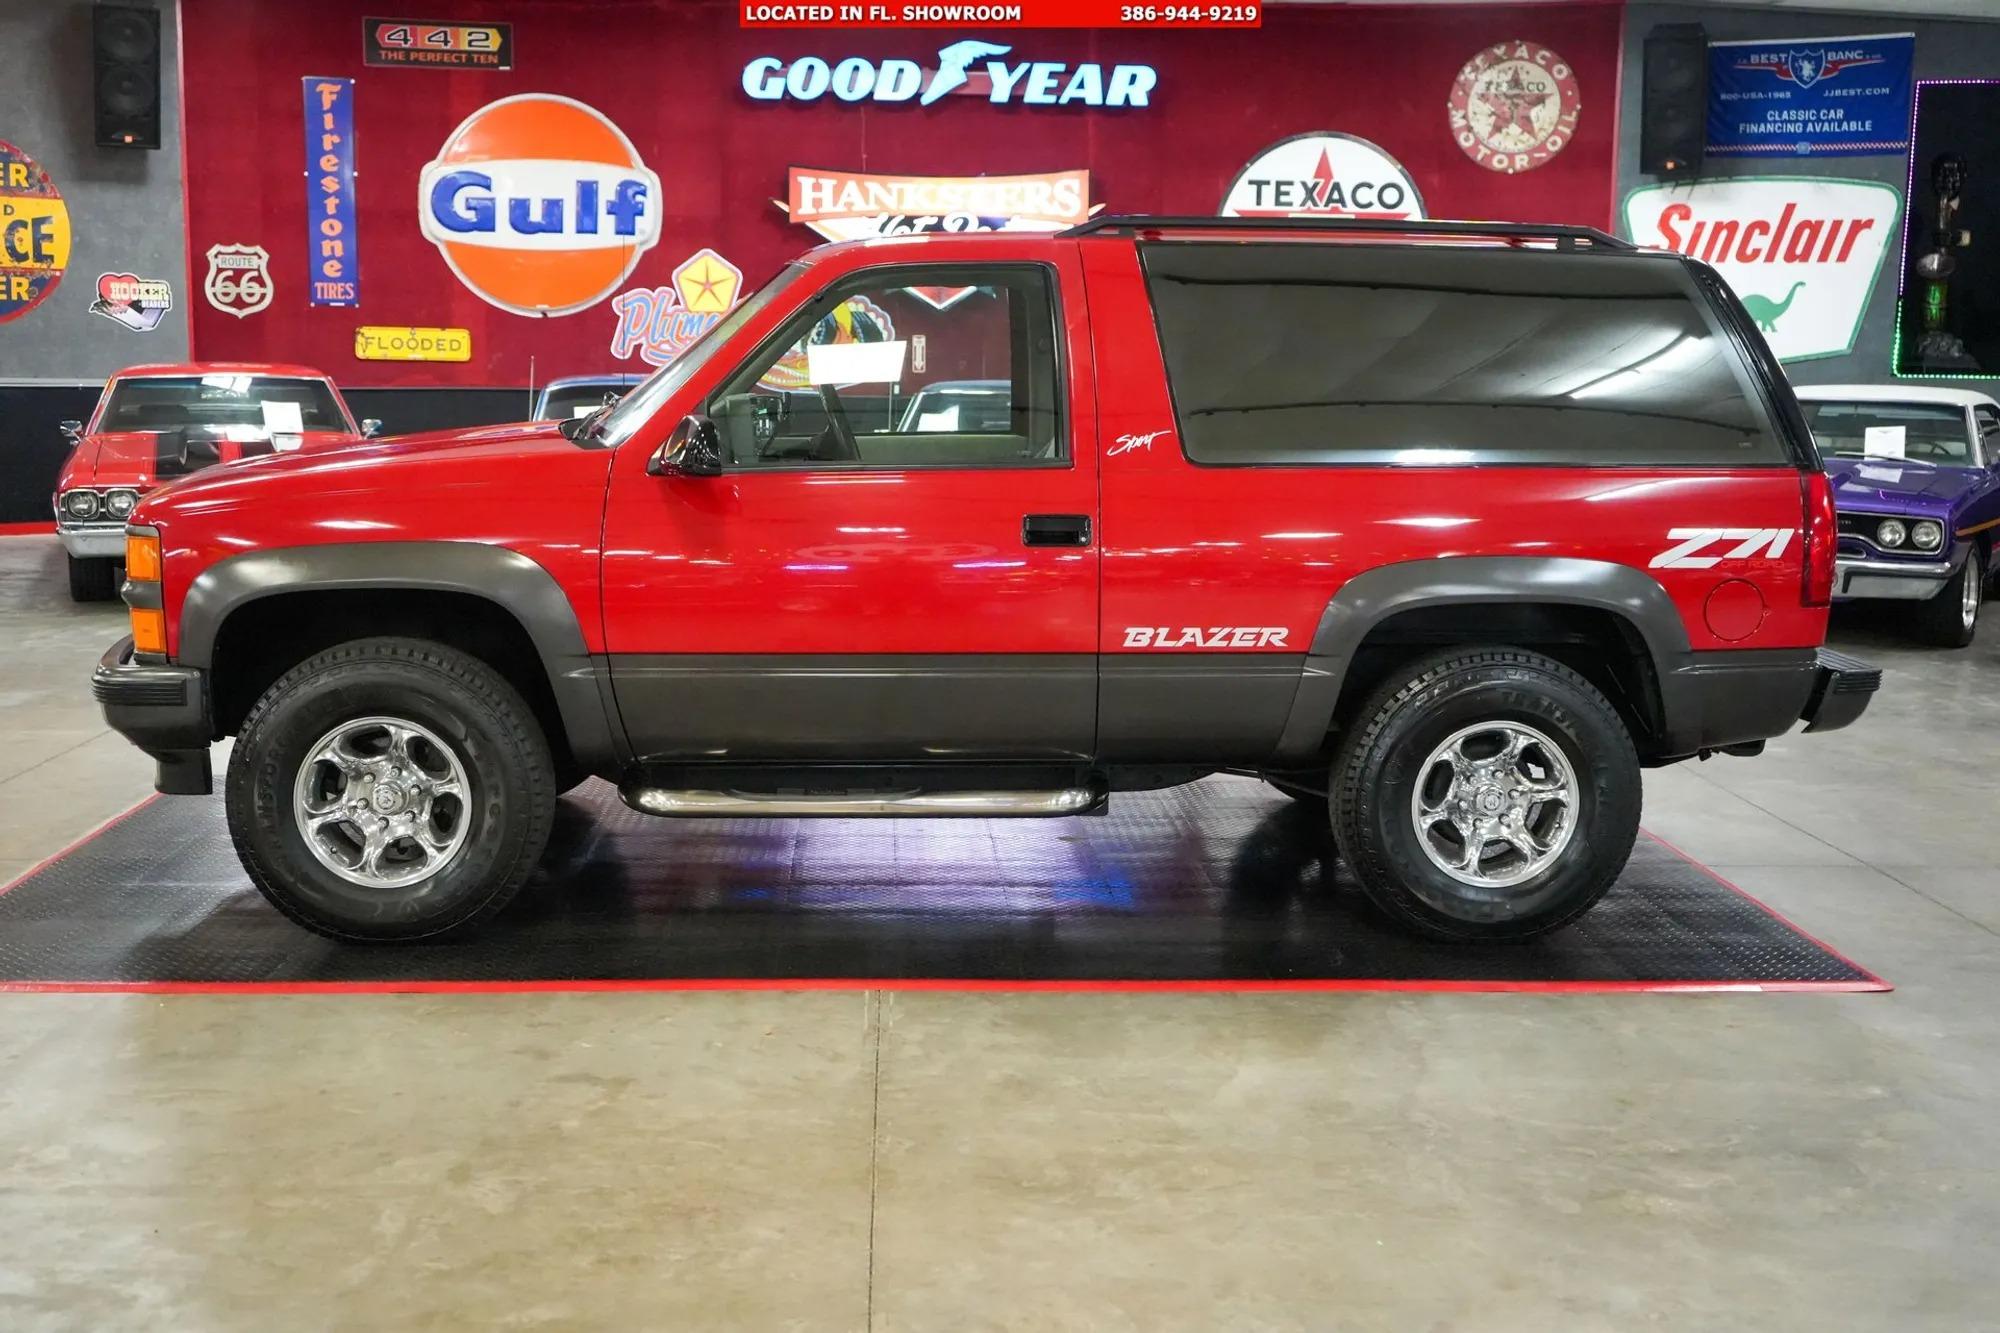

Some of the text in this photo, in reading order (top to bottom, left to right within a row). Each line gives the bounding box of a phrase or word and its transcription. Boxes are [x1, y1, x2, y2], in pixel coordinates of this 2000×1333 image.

[385, 27, 492, 50] 442
[380, 50, 499, 64] THE PERFECT TEN
[1750, 53, 1788, 65] BEST
[1827, 49, 1864, 61] BANC
[741, 56, 1158, 107] GOOD YEAR
[1823, 87, 1891, 98] JJBEST.COM
[1766, 108, 1845, 121] CLASSIC CAR
[1739, 120, 1873, 134] FINANCING AVAILABLE
[315, 83, 344, 278] Firestone
[431, 170, 648, 236] Gulf
[796, 175, 1082, 218] HANKSTERS
[1248, 179, 1405, 210] TEXACO
[1652, 203, 1875, 264] Sinclair
[220, 256, 255, 267] ROUTE
[214, 269, 261, 304] 66
[314, 281, 355, 299] TIRES
[364, 336, 462, 352] FLOODED
[1107, 430, 1171, 456] Sport
[1648, 527, 1795, 569] Z71
[1122, 626, 1289, 648] BLAZER
